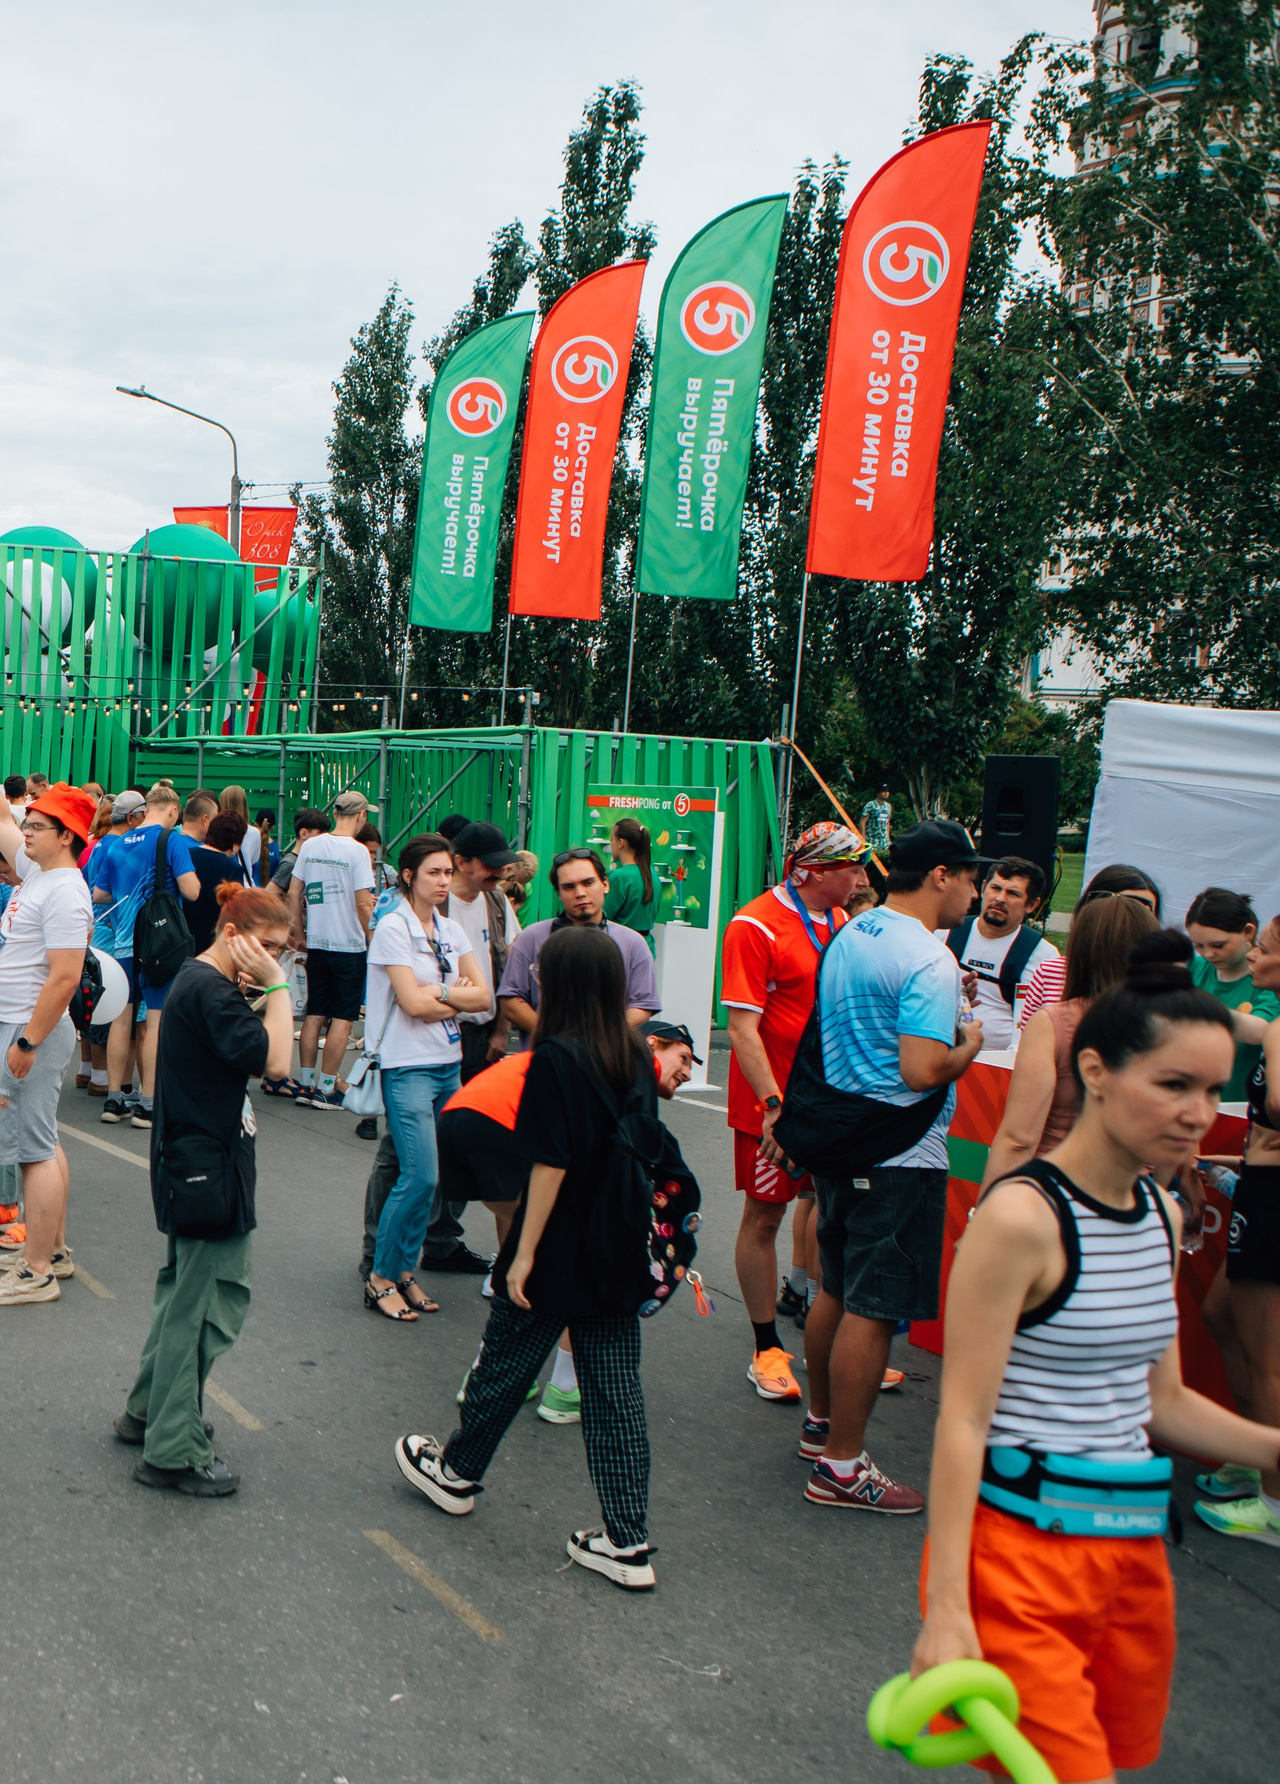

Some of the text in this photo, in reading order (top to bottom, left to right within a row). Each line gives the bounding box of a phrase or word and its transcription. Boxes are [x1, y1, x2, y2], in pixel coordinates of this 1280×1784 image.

[675, 377, 703, 530] выручает!
[700, 378, 735, 533] Пятёрочка
[851, 330, 890, 514] от 30 минут
[891, 330, 926, 479] Доставка
[246, 520, 291, 538] Омск
[440, 454, 464, 577] выручает!
[462, 456, 489, 579] Пятёрочка
[543, 422, 570, 564] от 30 минут
[570, 422, 597, 538] Доставка
[244, 543, 282, 560] 308
[609, 796, 660, 810] FRESHPONG
[855, 1480, 885, 1504] N
[1093, 1512, 1162, 1530] SILAPRO
